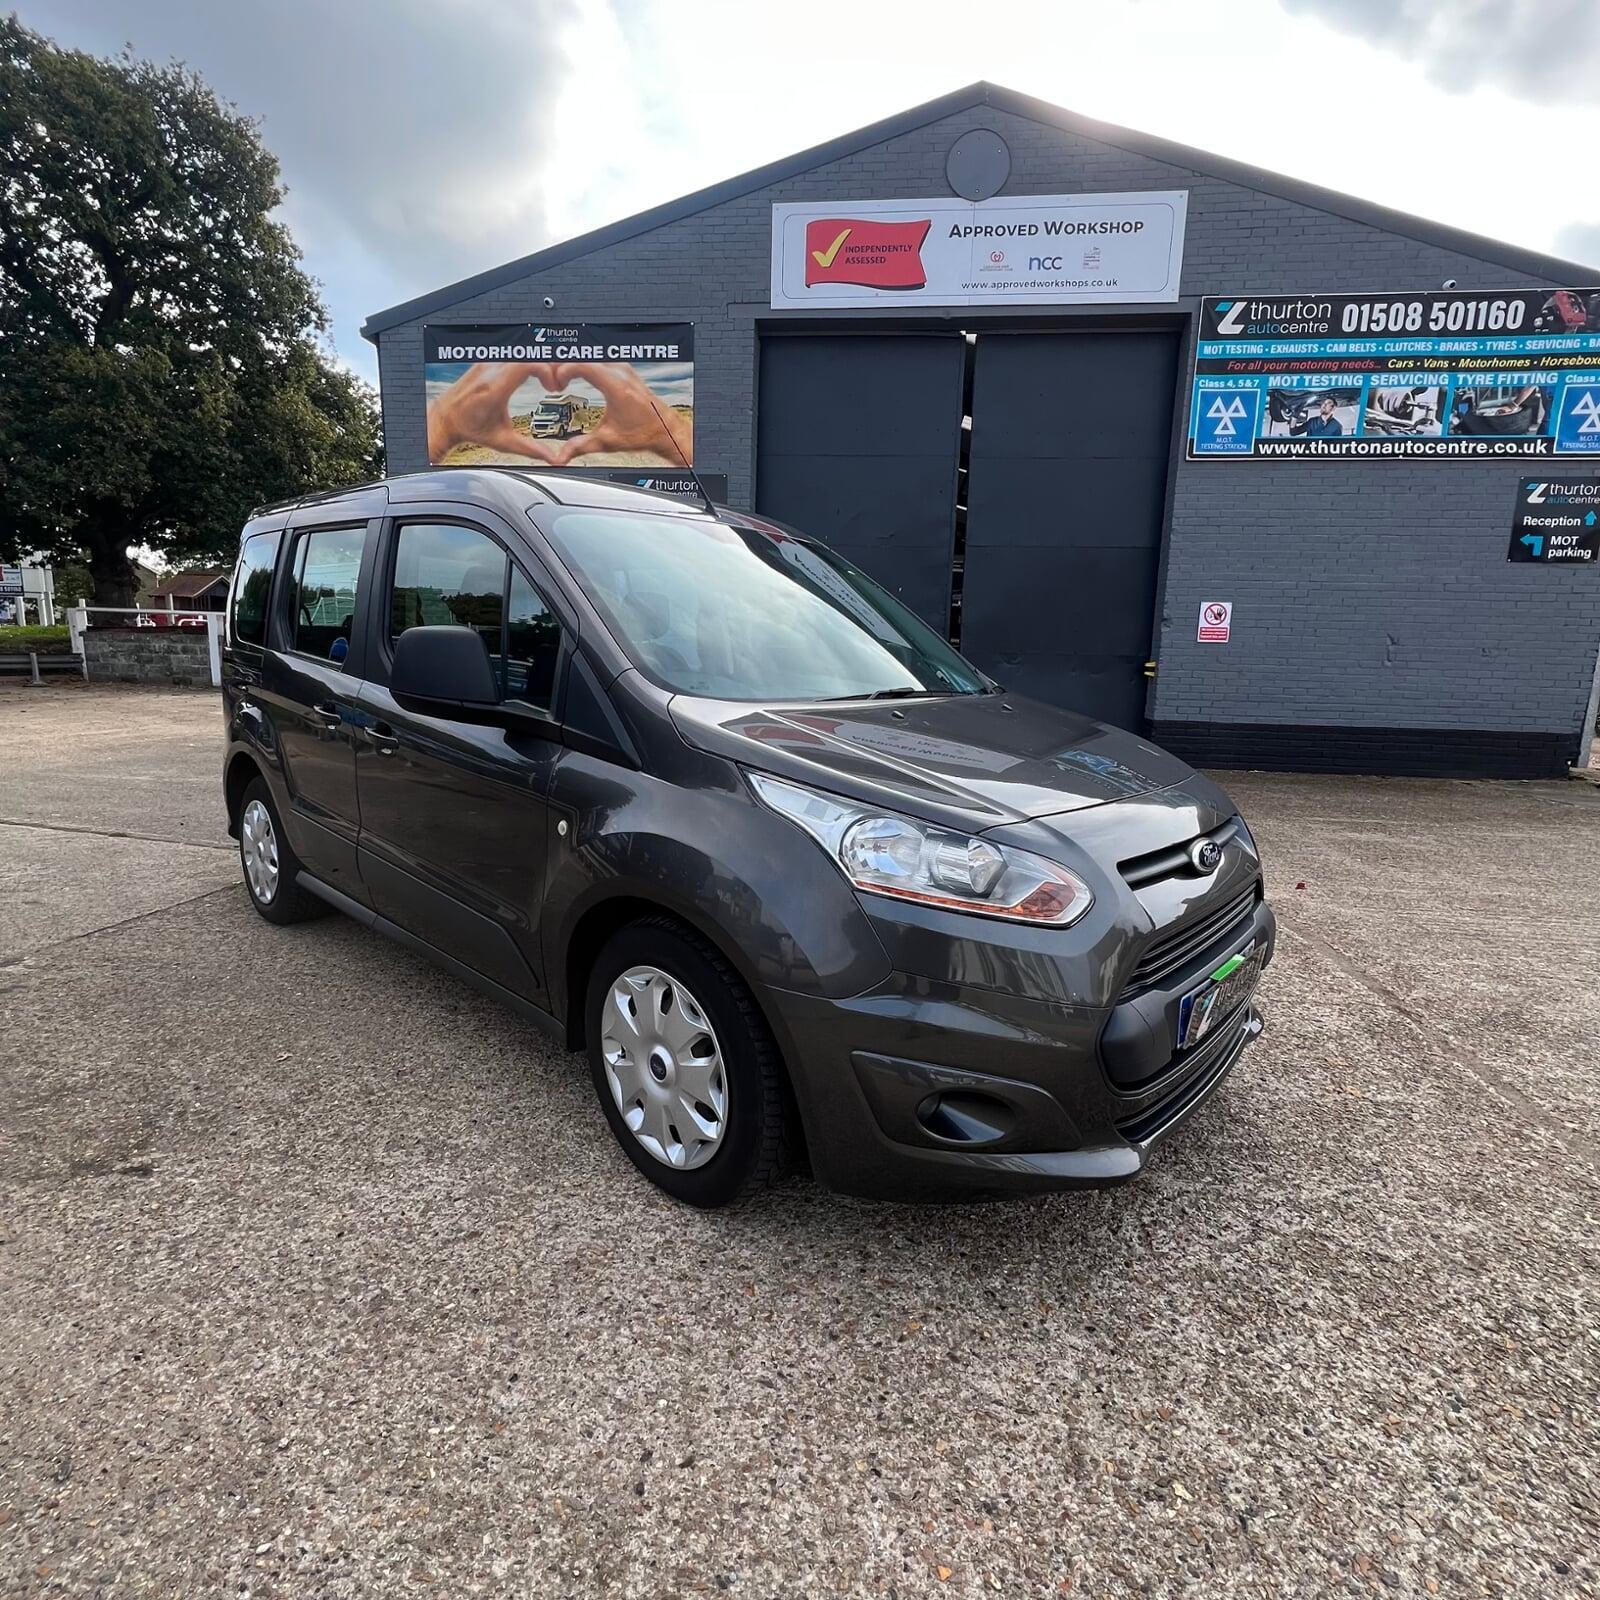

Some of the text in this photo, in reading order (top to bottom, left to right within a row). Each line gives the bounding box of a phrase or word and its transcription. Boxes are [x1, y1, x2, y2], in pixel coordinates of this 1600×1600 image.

[845, 244, 913, 253] INDEPENDENTLY
[845, 256, 886, 264] ASSESSED
[1029, 256, 1063, 271] ncc
[961, 279, 1118, 290] www.approvedworkshops.co.uk
[1250, 301, 1332, 320] thurton
[1341, 300, 1526, 332] 01508 501160
[547, 328, 579, 337] thurton
[1247, 321, 1329, 334] autocentre
[438, 345, 679, 360] MOTORHOME CARE CENTRE
[1203, 345, 1224, 354] MOT
[1225, 344, 1263, 354] TESTING
[1270, 343, 1319, 354] EXHAUSTS
[1326, 343, 1347, 353] CAM
[1348, 343, 1377, 352] BELTS
[1384, 342, 1433, 352] CLUTCHES
[1440, 341, 1478, 351] BRAKES
[1486, 341, 1517, 351] TYRES
[1524, 339, 1581, 350] SERVICING
[1227, 361, 1246, 370] For
[1248, 360, 1261, 370] all
[1262, 362, 1288, 372] your
[1289, 360, 1340, 372] motoring
[1387, 359, 1414, 368] Cars
[1424, 358, 1449, 368] Vans
[1458, 357, 1531, 368] Motorhomes
[1198, 379, 1225, 388] Class
[1268, 375, 1363, 387] MOT TESTING
[1370, 374, 1449, 385] SERVICING
[1457, 372, 1558, 384] TYRE FITTING
[1258, 439, 1548, 455] www.thurtonautocentre.co.uk
[655, 480, 699, 490] thurton
[1523, 515, 1581, 528] Reception
[1550, 536, 1579, 546] MOT
[1548, 547, 1592, 559] parking
